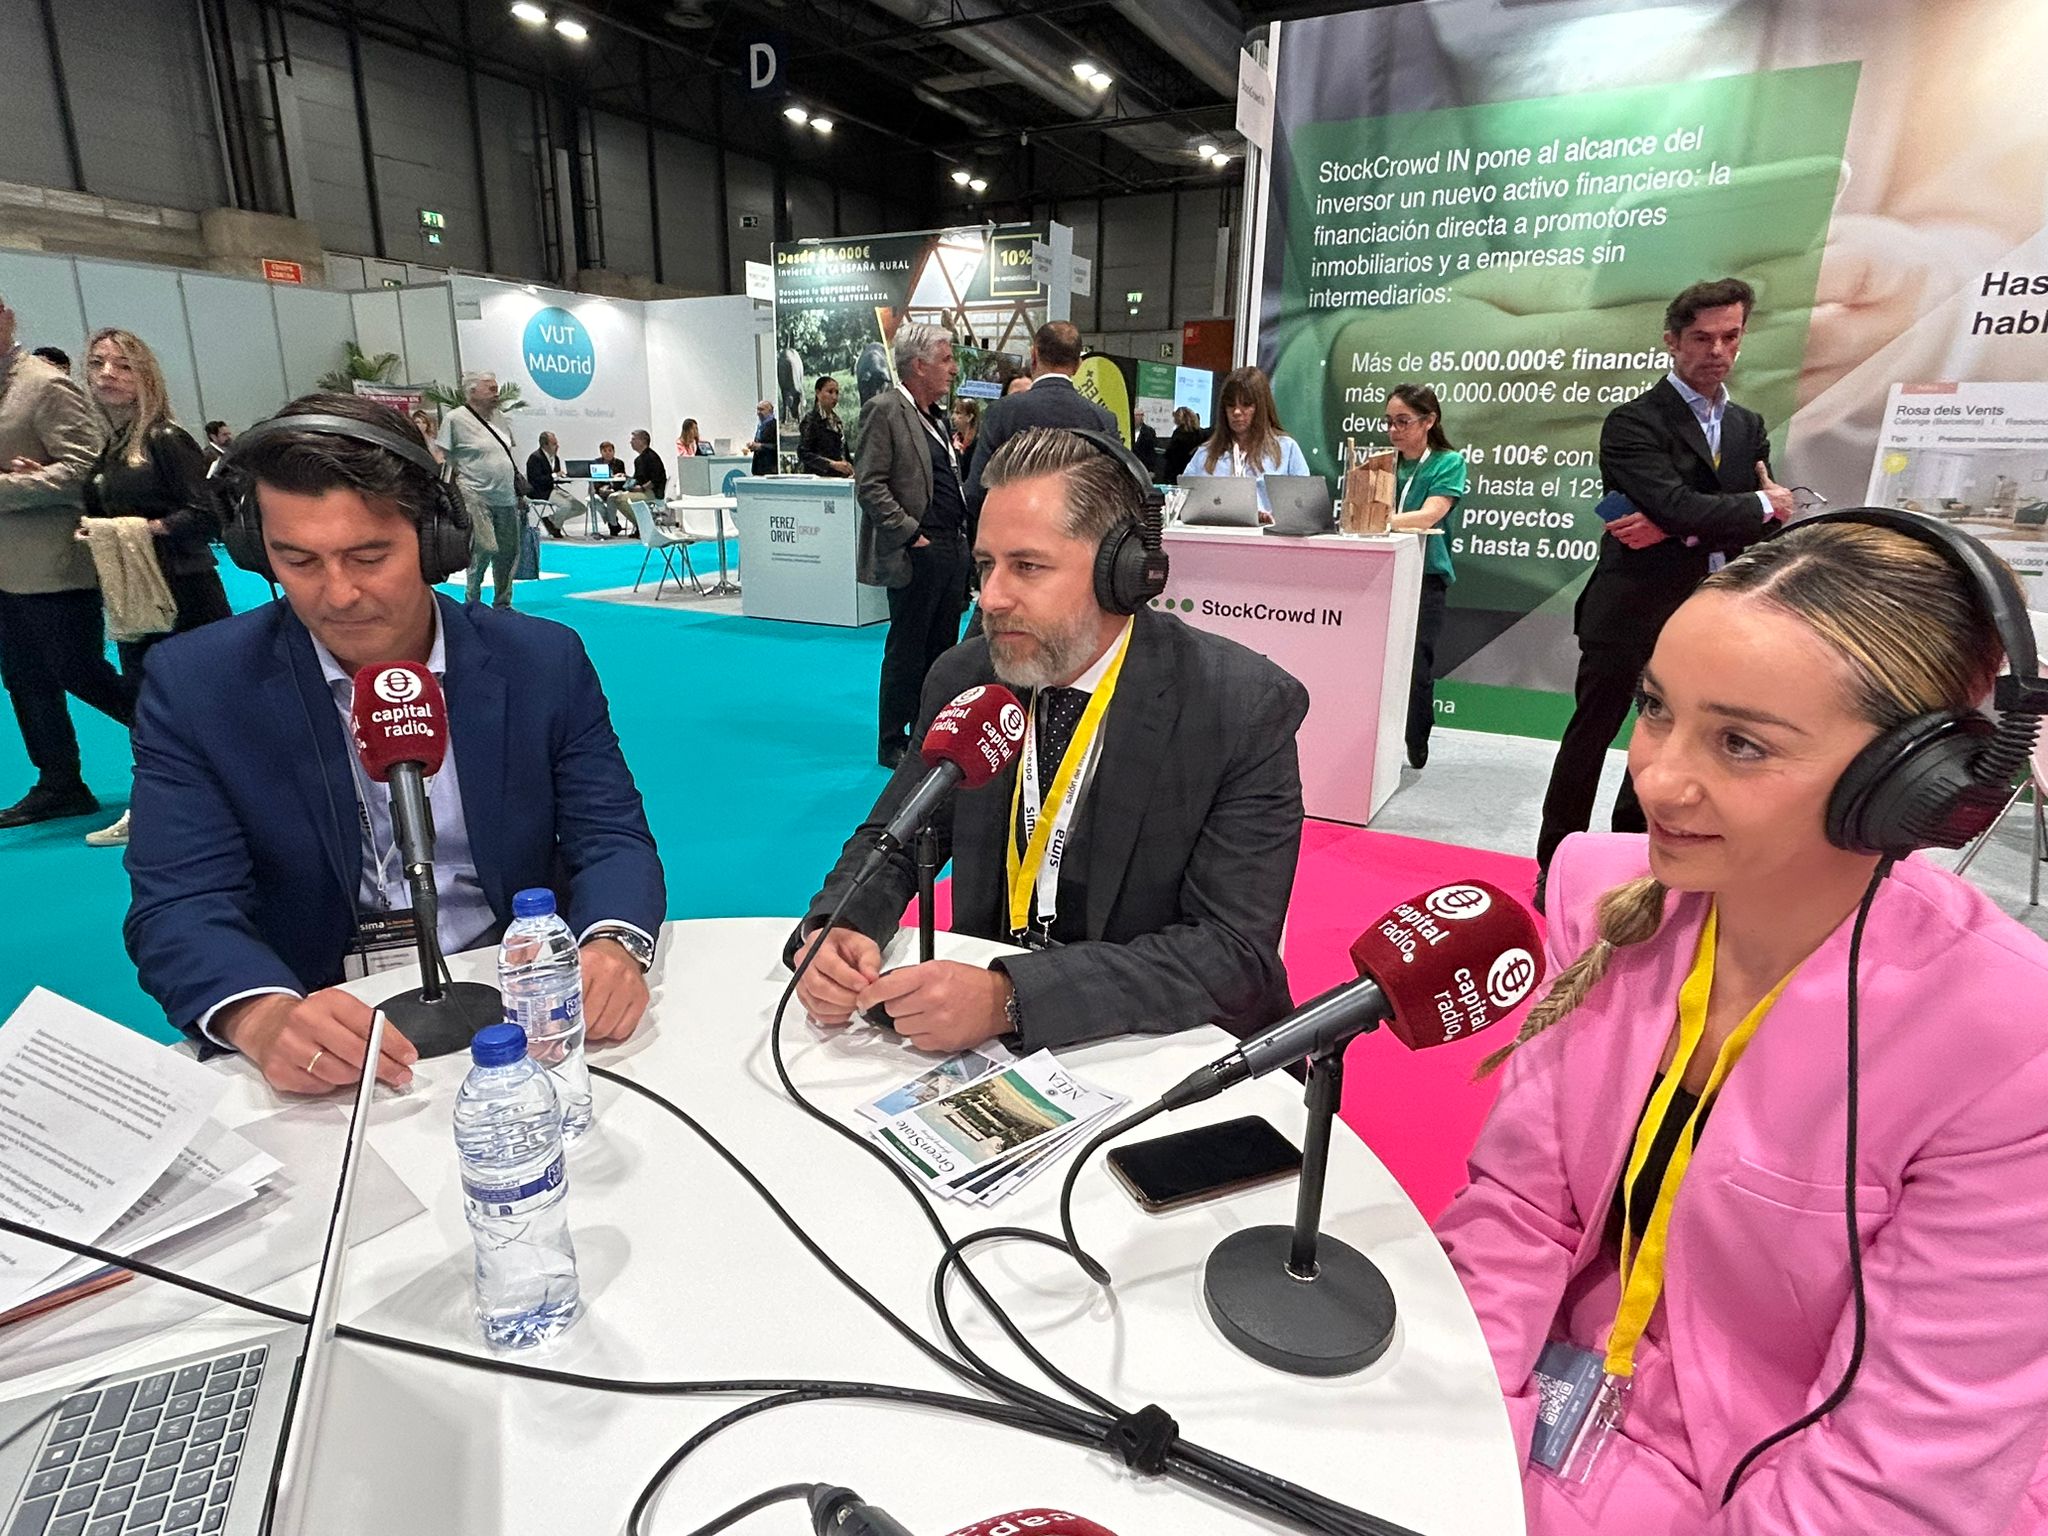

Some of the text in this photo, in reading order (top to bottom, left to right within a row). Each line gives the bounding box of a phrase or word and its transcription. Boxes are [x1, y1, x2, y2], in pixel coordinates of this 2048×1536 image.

[750, 43, 776, 88] D
[1319, 125, 1704, 183] StockCrowd IN pone al alcance del
[1316, 161, 1731, 215] inversor un nuevo activo financiero: la
[1314, 206, 1667, 246] financiación directa a promotores
[841, 261, 876, 274] ESPAÑA
[879, 260, 910, 271] RURAL
[1001, 249, 1033, 266] 10%
[1311, 240, 1626, 277] inmobiliarios y a empresas sin
[1309, 283, 1452, 308] intermediarios:
[1981, 272, 2048, 296] Has
[538, 324, 575, 345] VUT
[529, 352, 591, 375] MADrid
[1352, 352, 1393, 373] Más
[1398, 352, 1423, 372] de
[1428, 349, 1565, 372] 85.000.000€
[1345, 381, 1654, 403] más 0.000.000€ de capit
[1896, 405, 2005, 416] Rosa dels Vents
[2005, 417, 2048, 426] Residenc
[1492, 445, 1548, 466] 100€
[1554, 449, 1593, 467] con
[1477, 475, 1534, 496] hasta
[1541, 477, 1560, 497] el
[770, 516, 795, 529] PEREZ
[1462, 508, 1575, 531] proyectos
[770, 530, 795, 543] ORIVE
[1470, 535, 1530, 557] hasta
[1536, 538, 1600, 562] 5.000.
[1202, 599, 1343, 626] StockCrowd IN
[371, 703, 433, 723] capital
[981, 721, 1014, 762] capital
[1049, 828, 1066, 868] sima
[360, 921, 385, 931] sima
[1393, 904, 1450, 946] capital
[1454, 968, 1492, 1032] capital
[895, 1119, 955, 1173] GreenState
